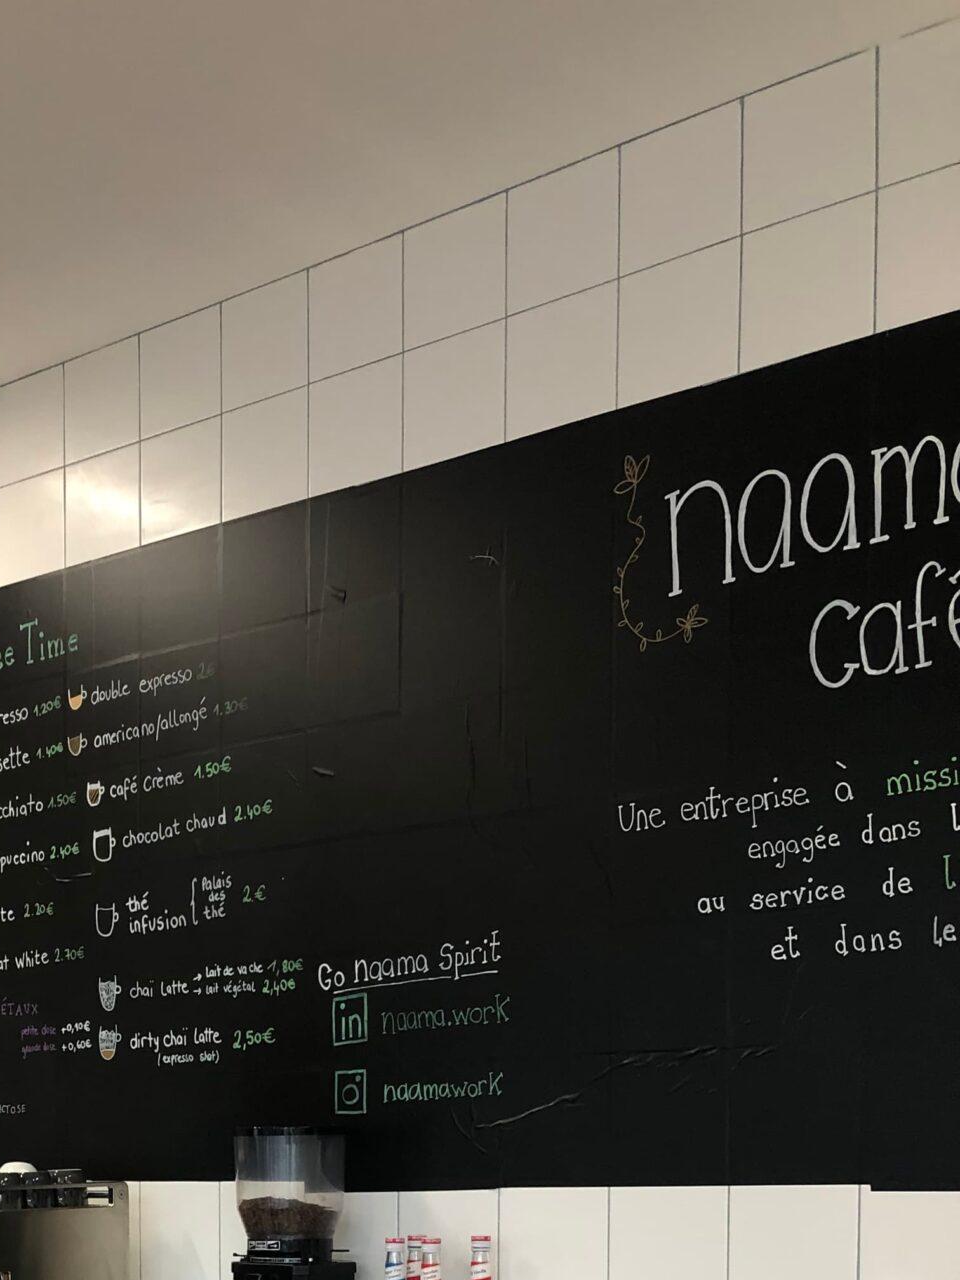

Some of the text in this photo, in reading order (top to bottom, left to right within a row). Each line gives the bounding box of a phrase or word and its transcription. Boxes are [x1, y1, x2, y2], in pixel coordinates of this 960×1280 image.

[664, 435, 960, 598] naam
[20, 618, 79, 665] Time
[91, 680, 131, 705] double
[139, 668, 193, 696] expresso
[33, 695, 62, 717] 1.20€
[93, 697, 208, 749] americano/allongé
[36, 742, 64, 759] 1.40€
[109, 776, 138, 800] café
[194, 756, 232, 779] 1.50€
[48, 792, 77, 809] 1.50€
[617, 757, 960, 833] Une entreprise à missi
[122, 800, 273, 848] chocolat chaud 2.40€
[50, 842, 80, 860] 2.40€
[747, 813, 922, 869] engagée dans
[126, 891, 150, 912] thé
[208, 890, 226, 902] des
[697, 866, 914, 914] au service de
[129, 909, 187, 934] infusion
[203, 903, 226, 920] thé
[770, 925, 801, 962] et
[835, 923, 903, 957] dans
[223, 965, 234, 976] de
[267, 959, 304, 977] 1,80€
[318, 930, 502, 990] Go naama Spirit
[223, 980, 256, 998] végétal
[262, 979, 296, 997] 2,40€
[129, 1031, 160, 1053] dirty
[232, 1027, 276, 1051] 2,50€
